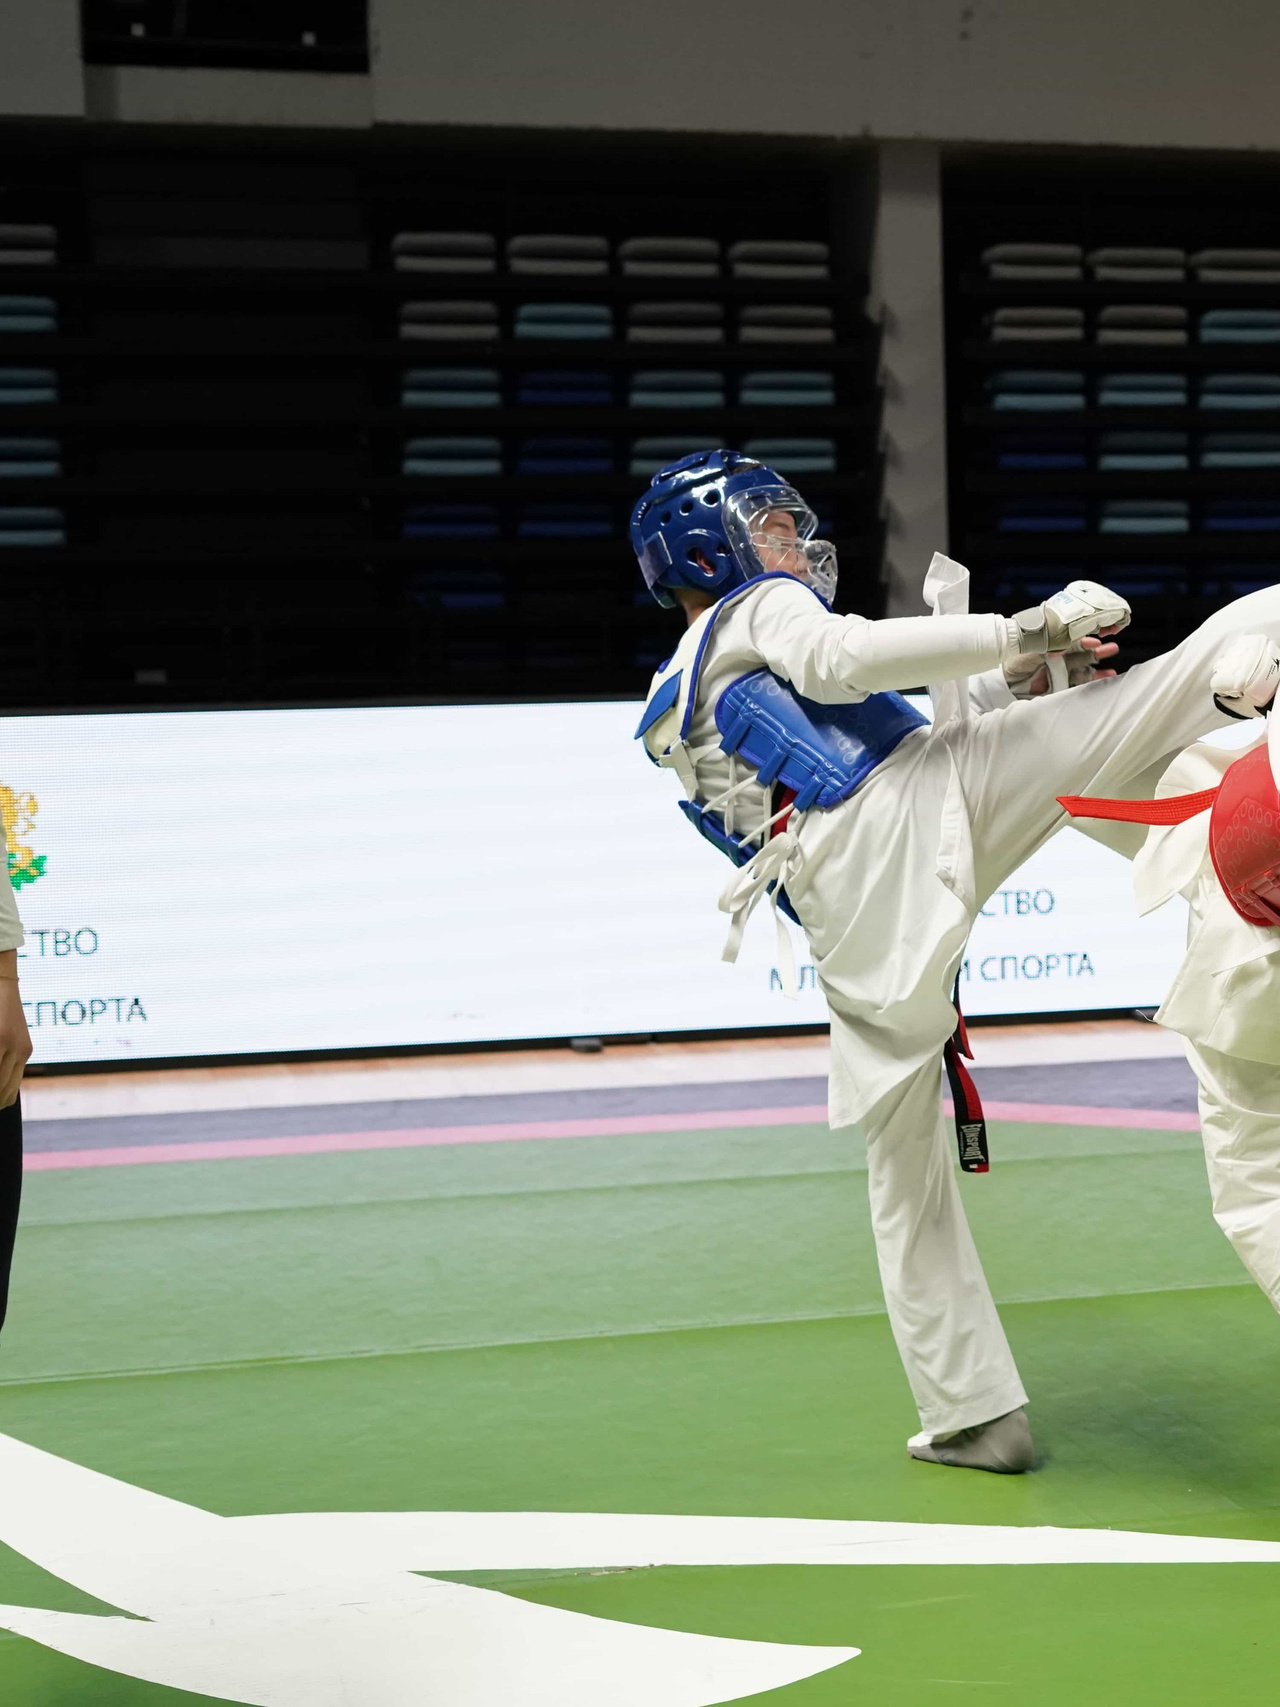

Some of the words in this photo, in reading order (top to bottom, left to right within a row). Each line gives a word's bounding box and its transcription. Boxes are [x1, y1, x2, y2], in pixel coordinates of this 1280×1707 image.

[980, 888, 1055, 917] ТВО
[980, 953, 1094, 981] СПОРТА
[22, 998, 147, 1028] ПОРТА
